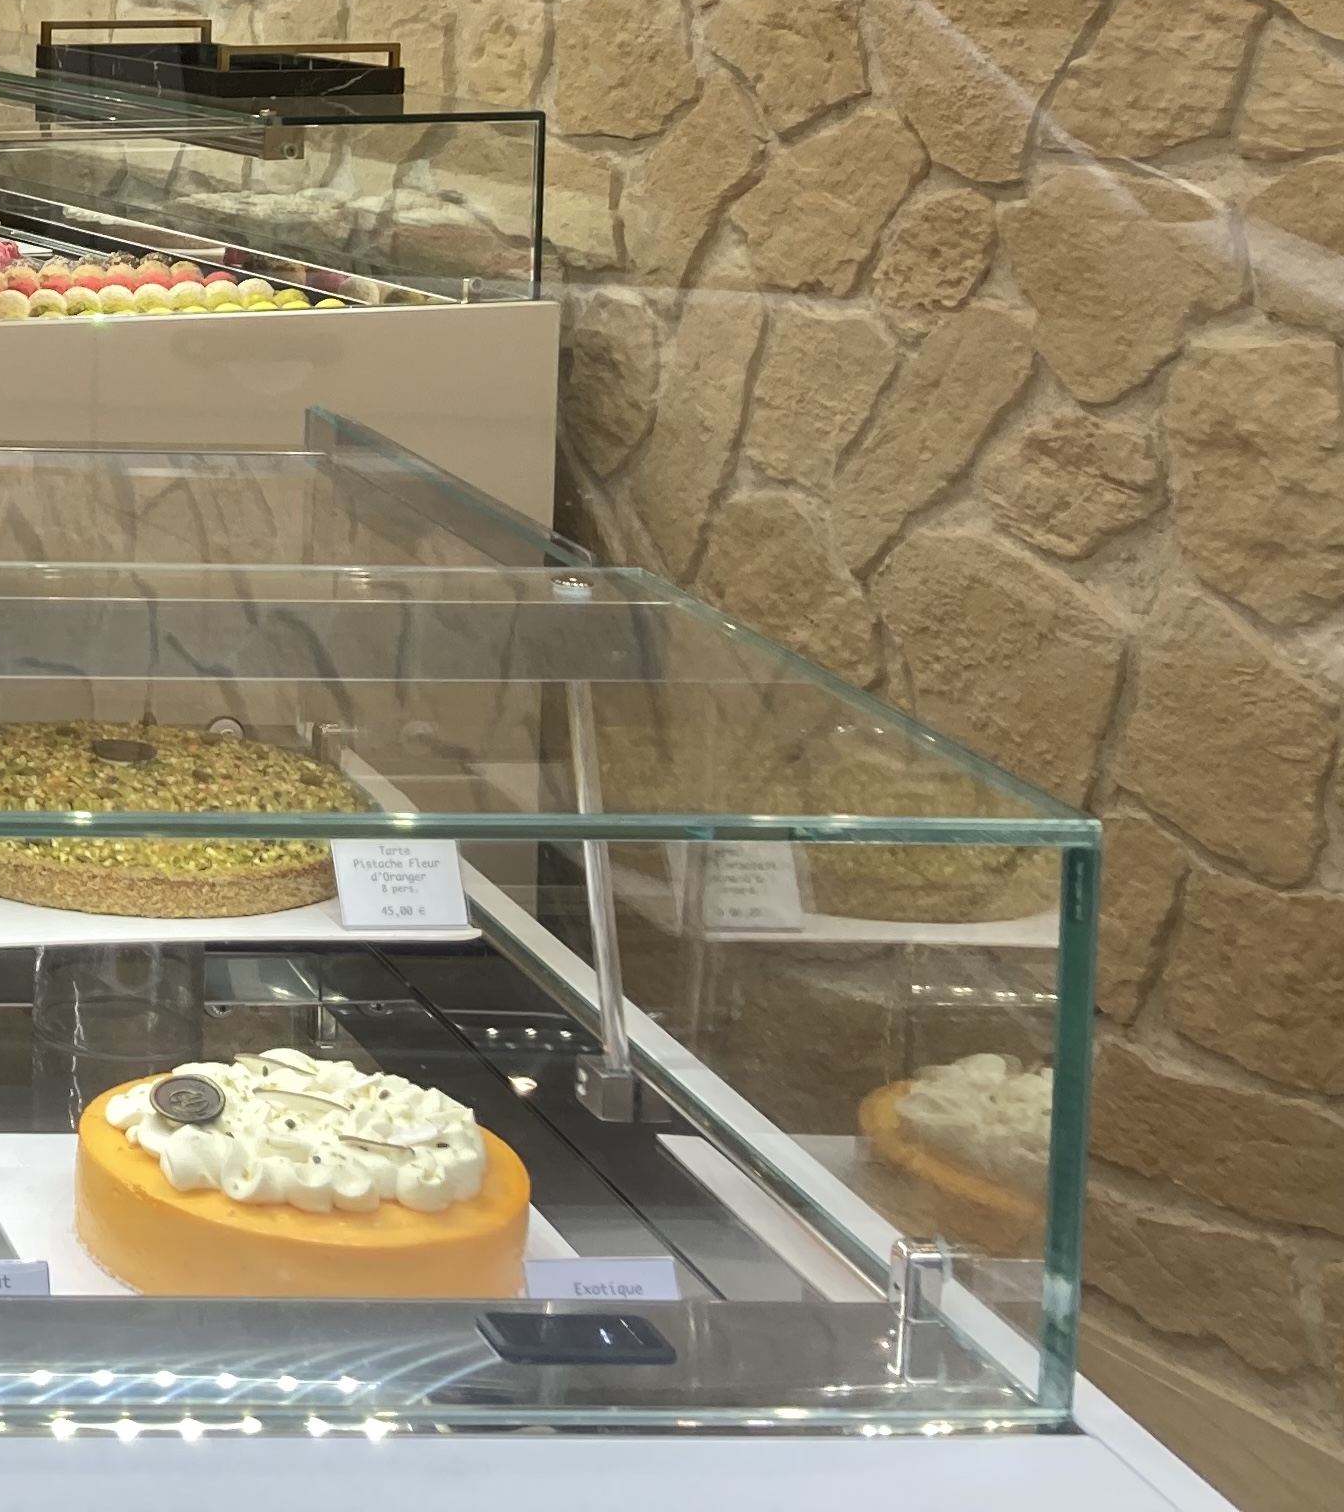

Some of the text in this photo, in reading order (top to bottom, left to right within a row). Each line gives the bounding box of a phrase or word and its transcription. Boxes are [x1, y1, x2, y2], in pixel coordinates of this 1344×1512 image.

[378, 845, 411, 856] Tarte
[353, 858, 441, 869] Pistache Fleur
[370, 871, 427, 884] d'Oranger
[381, 906, 414, 918] 45,00
[573, 1281, 644, 1298] Exotique
